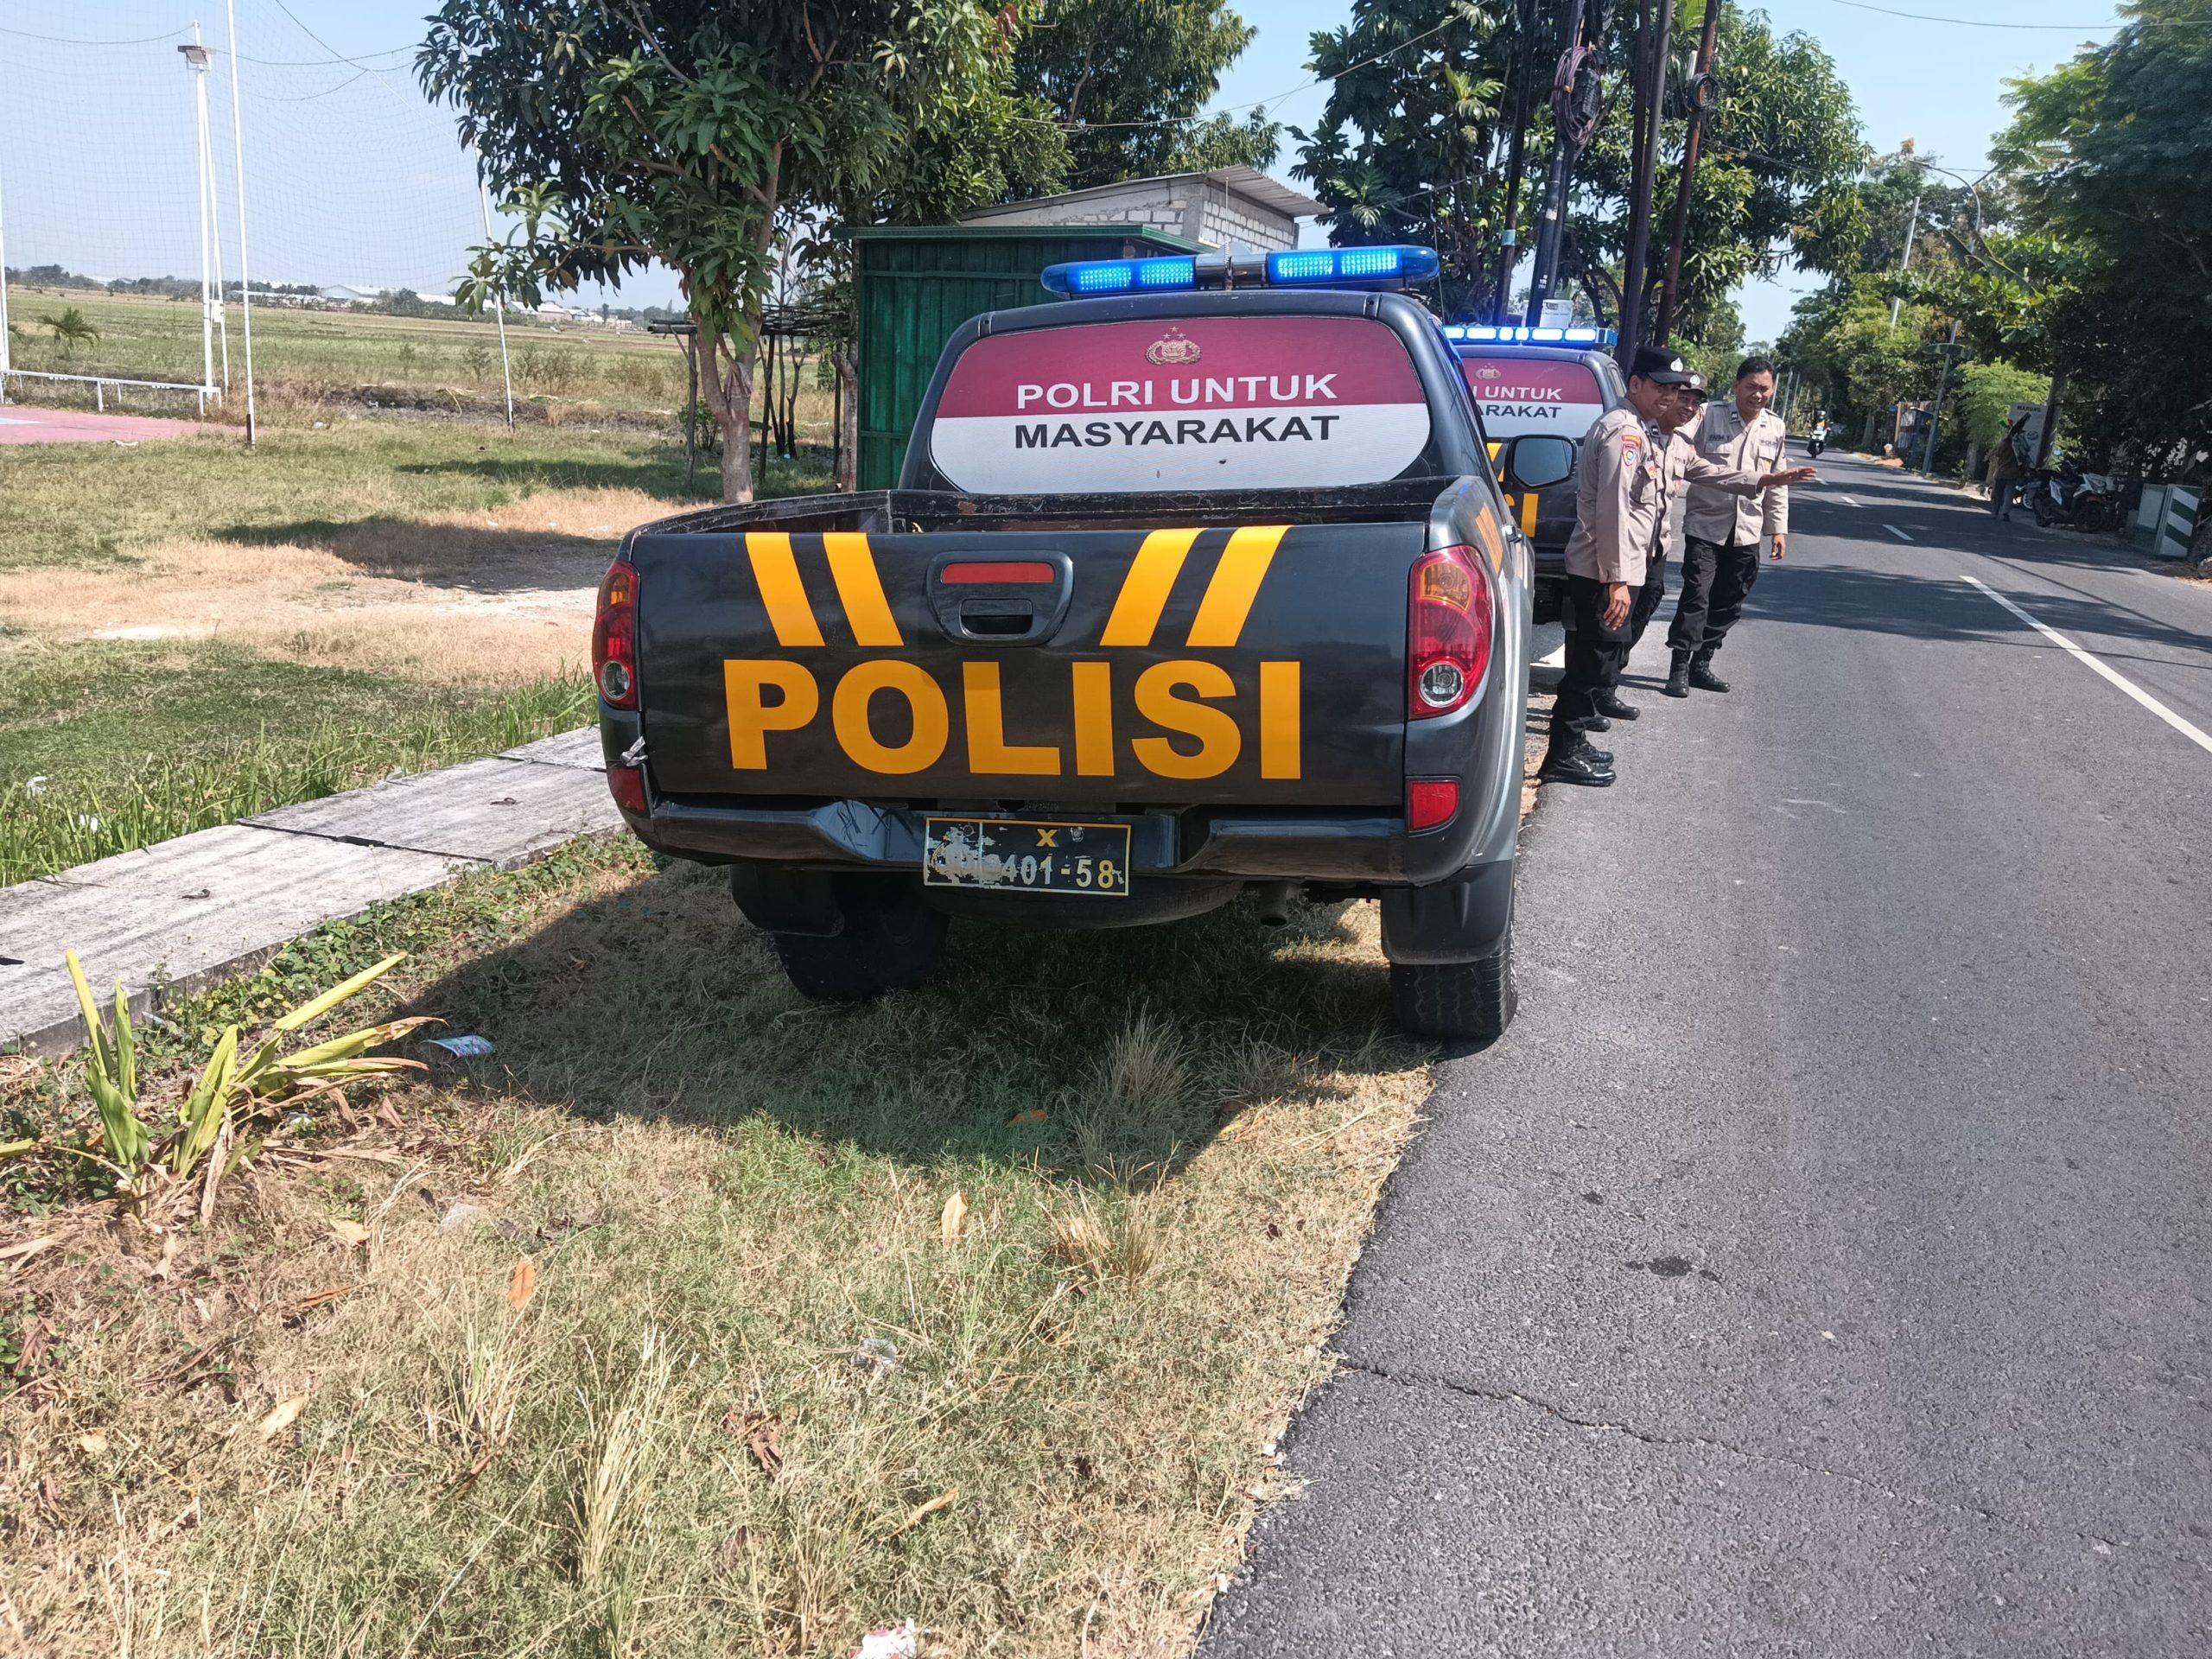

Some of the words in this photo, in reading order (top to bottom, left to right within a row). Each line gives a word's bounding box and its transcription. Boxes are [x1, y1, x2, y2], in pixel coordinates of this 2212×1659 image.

[1017, 380, 1154, 409] POLRI
[1170, 373, 1338, 404] UNTUK
[1484, 386, 1562, 400] UNTUK
[1014, 416, 1339, 448] MASYARAKAT
[723, 659, 1302, 779] POLISI
[1037, 829, 1059, 848] X
